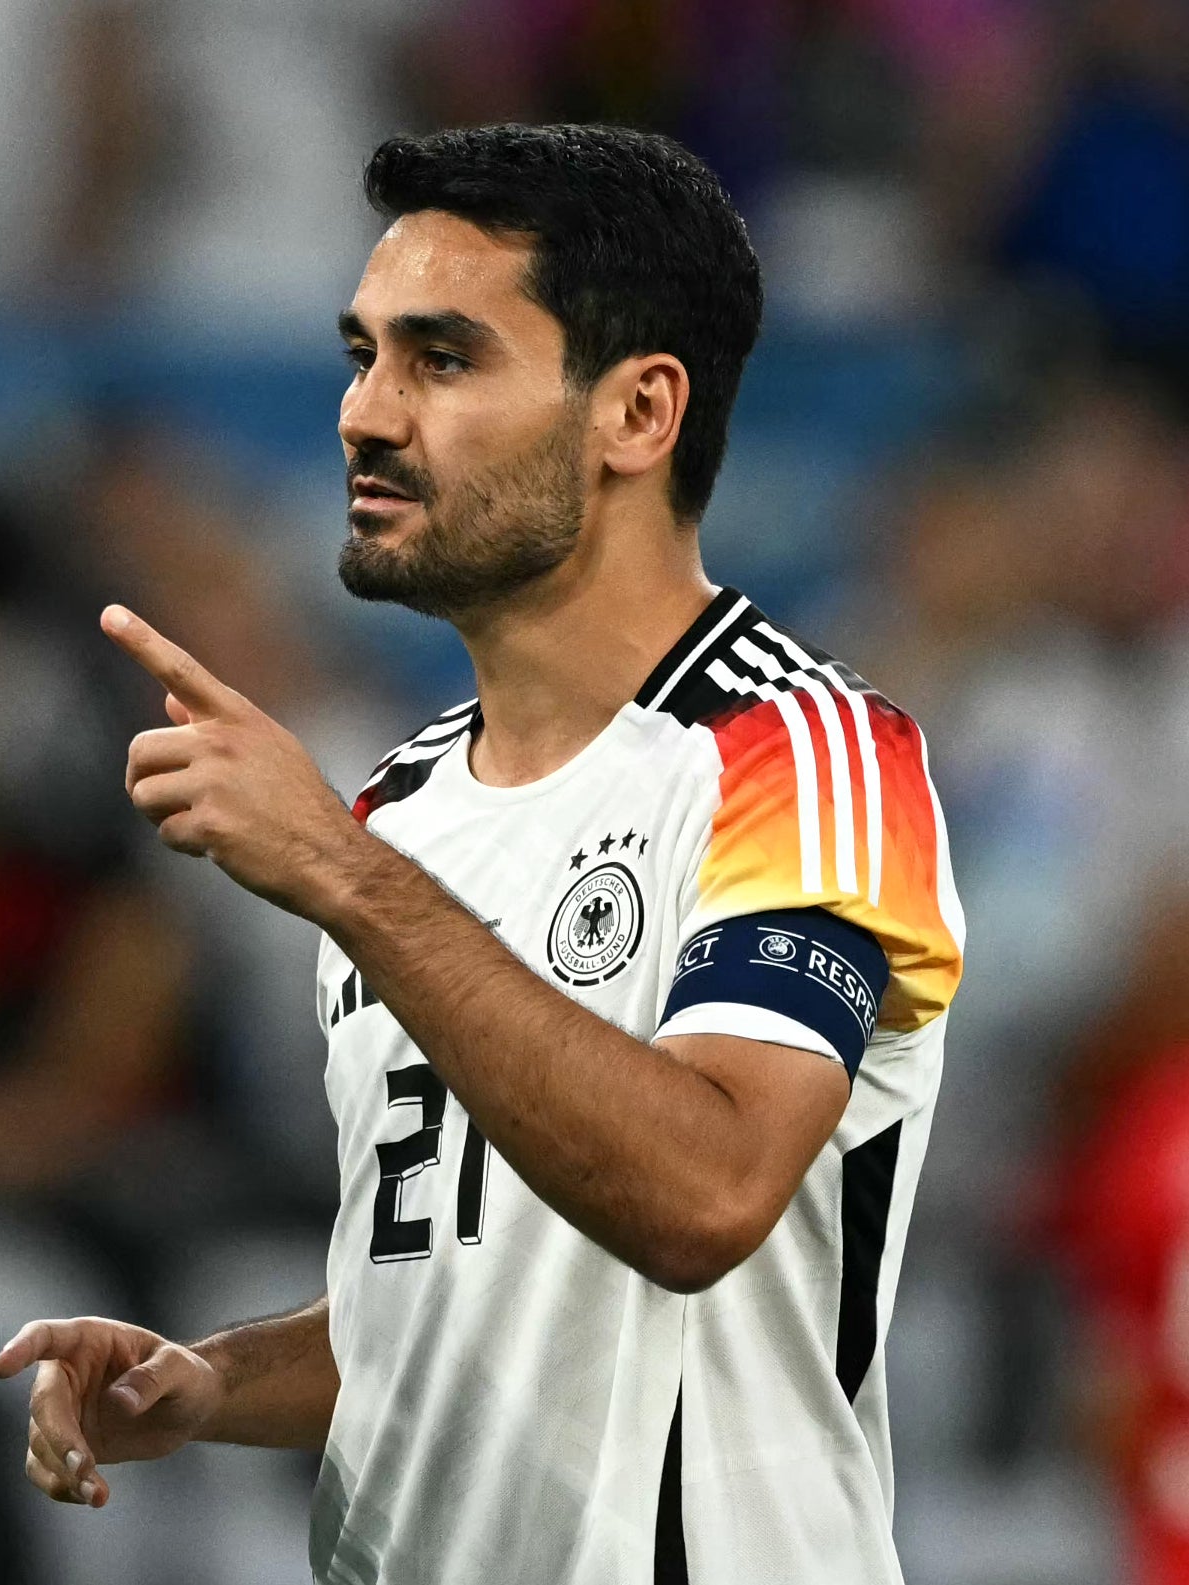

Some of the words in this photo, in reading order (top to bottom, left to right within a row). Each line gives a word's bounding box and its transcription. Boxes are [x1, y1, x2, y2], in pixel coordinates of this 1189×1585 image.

[575, 878, 624, 903] DEUTSCHER
[560, 933, 625, 969] FUSSBALL-BUND
[370, 1063, 491, 1264] 21
